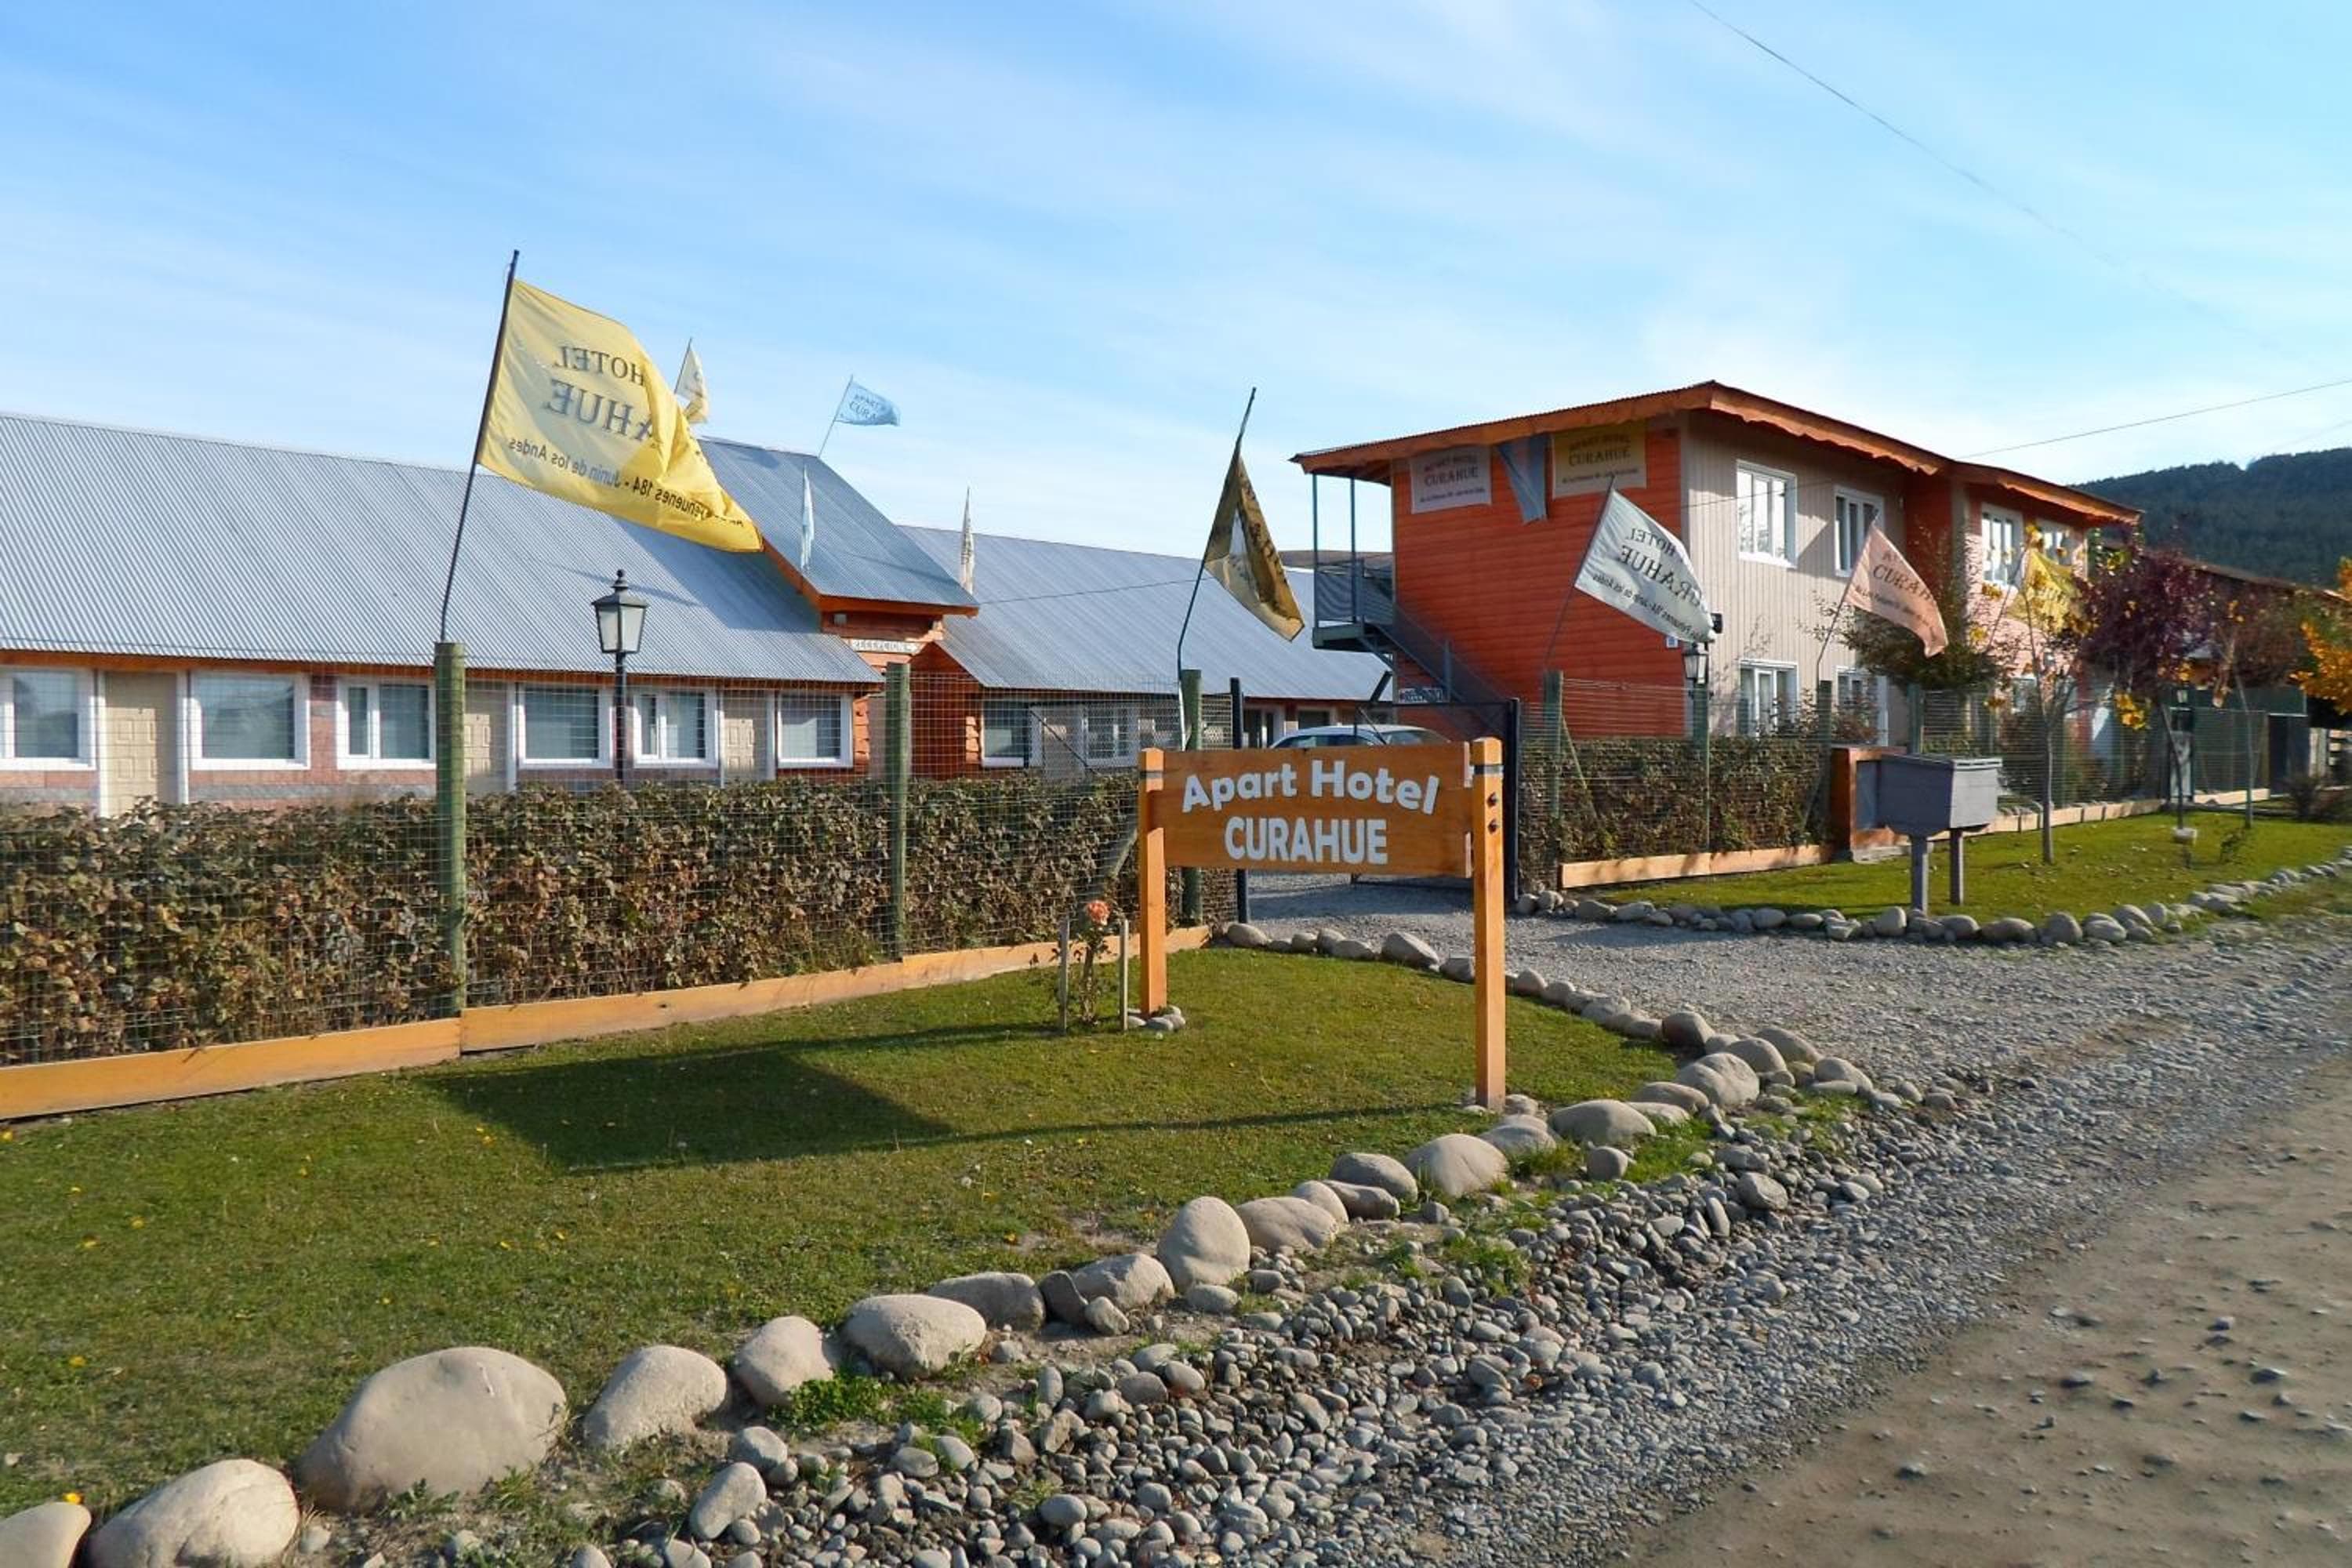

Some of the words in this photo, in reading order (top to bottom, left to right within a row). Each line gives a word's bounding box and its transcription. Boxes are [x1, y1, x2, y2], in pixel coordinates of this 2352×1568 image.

[1181, 762, 1299, 814] Apart
[1310, 759, 1440, 815] Hotel
[1224, 815, 1389, 865] CURAHUE
